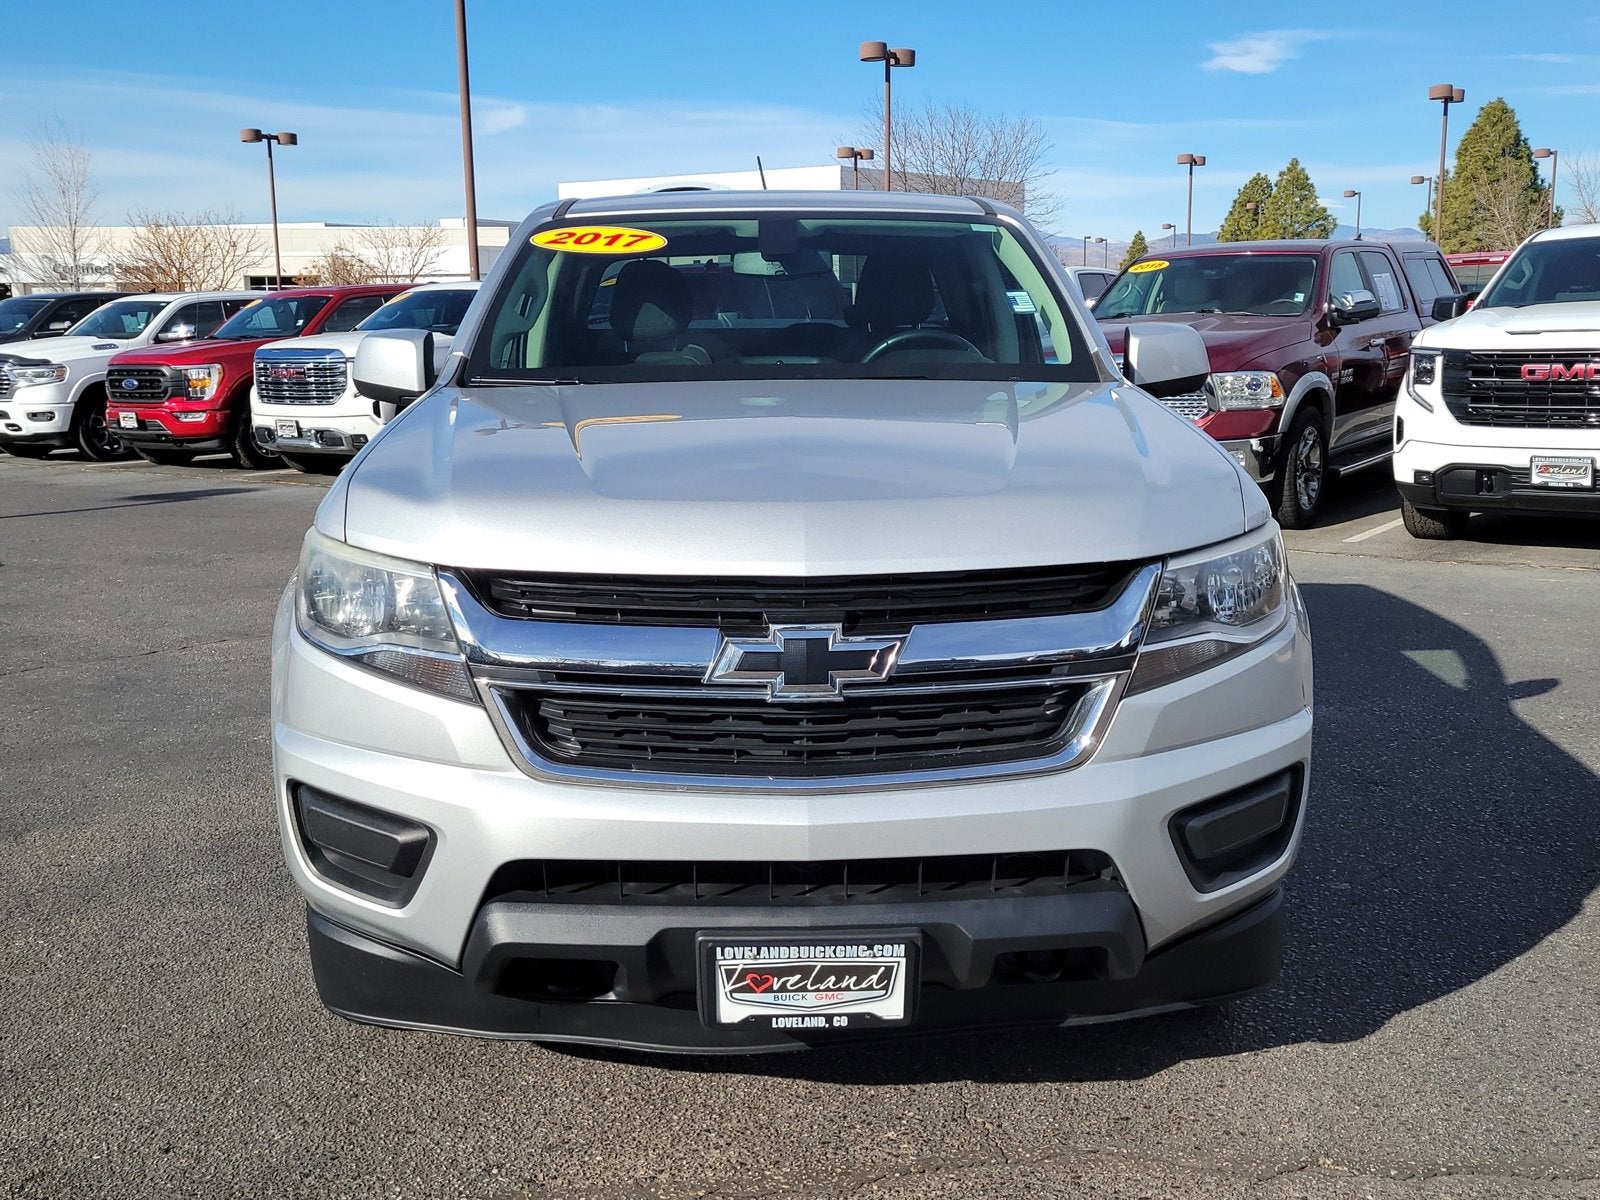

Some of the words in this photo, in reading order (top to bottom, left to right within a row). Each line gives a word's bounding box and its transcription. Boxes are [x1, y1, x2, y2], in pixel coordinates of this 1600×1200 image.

[544, 231, 653, 248] 2017
[716, 945, 905, 960] LOVELANDBUICKGMC.COM
[773, 994, 808, 1002] BUICK
[814, 993, 844, 1001] GMC
[772, 1017, 829, 1028] LOVELAND,
[833, 1016, 848, 1027] CO
